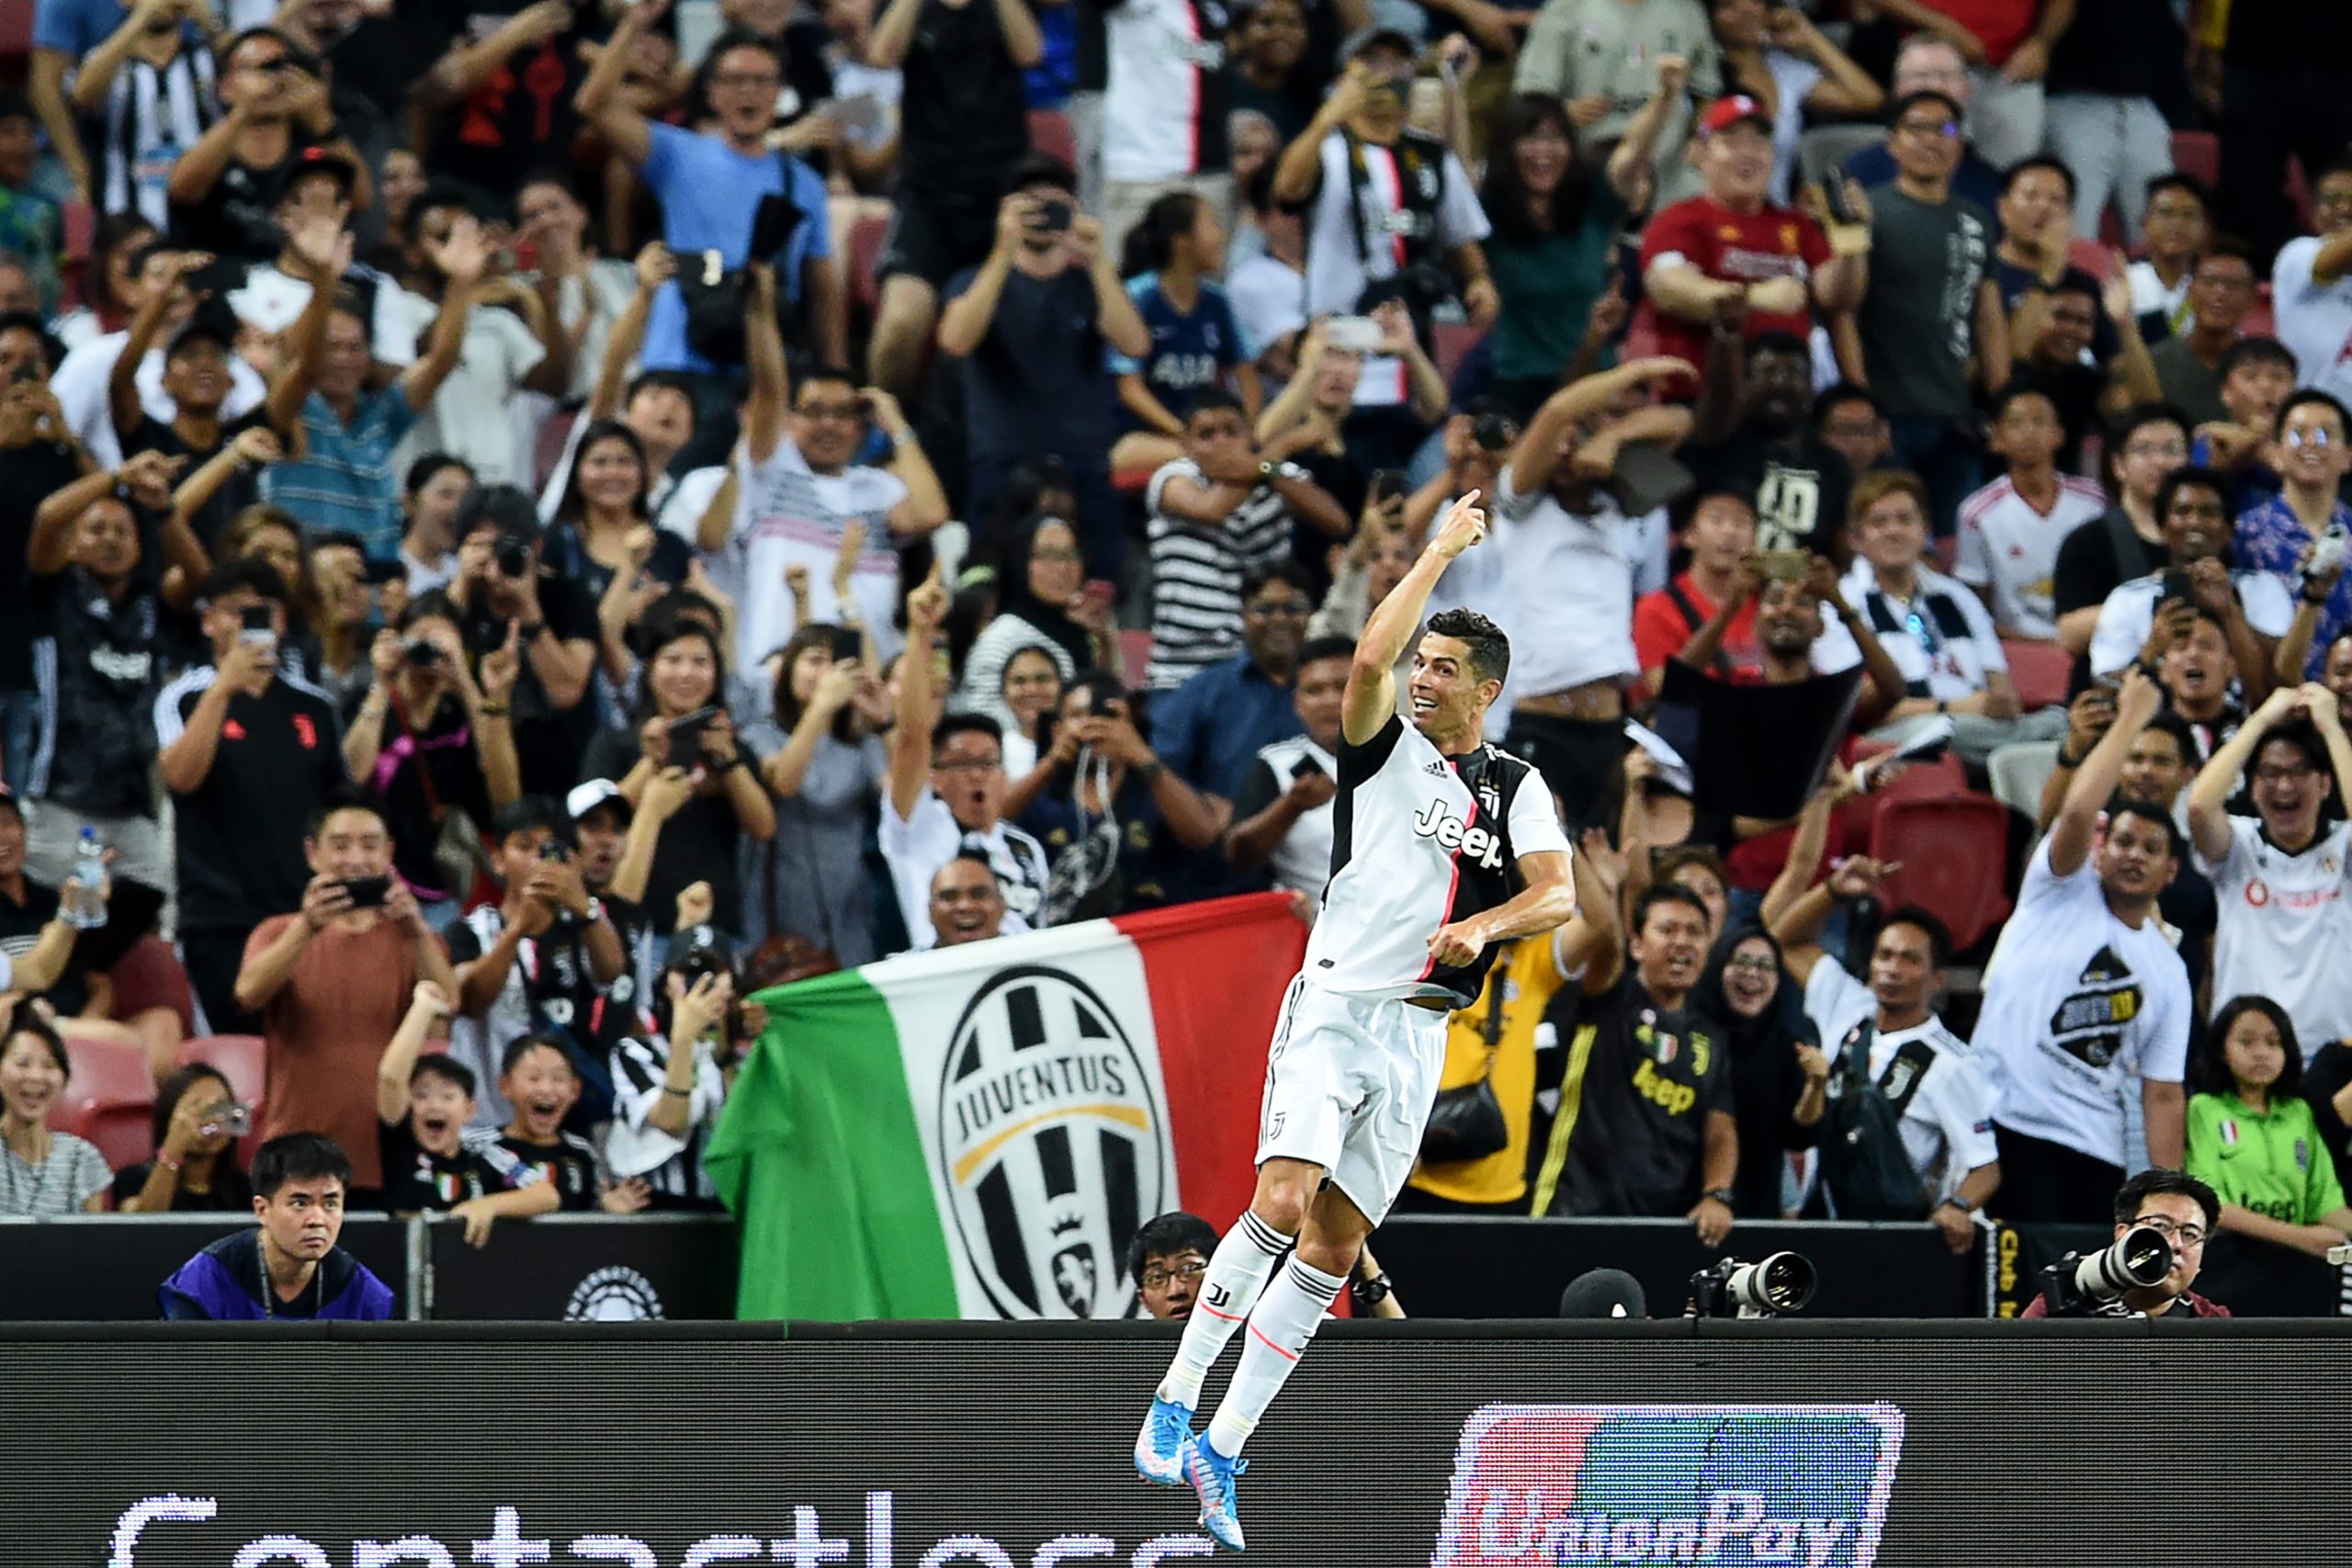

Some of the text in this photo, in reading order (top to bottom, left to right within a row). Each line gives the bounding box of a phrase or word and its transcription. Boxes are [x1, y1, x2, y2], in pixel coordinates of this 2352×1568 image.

[1412, 797, 1504, 869] Jeep
[956, 1055, 1126, 1142] JUVENTUS
[1999, 1229, 2018, 1292] Club
[1478, 1489, 1858, 1567] UnionPay
